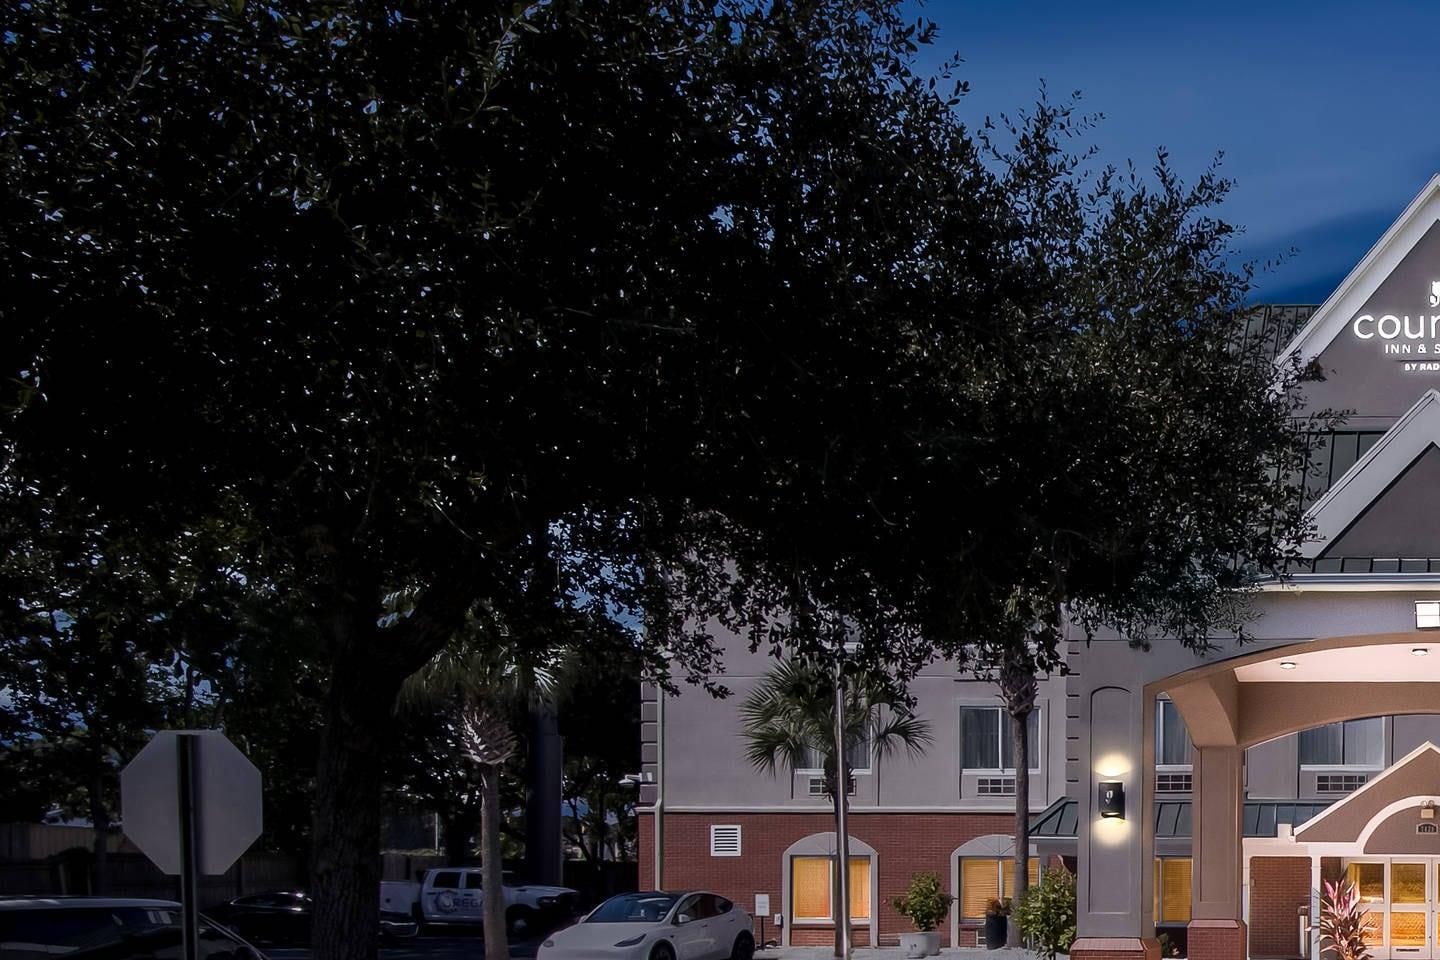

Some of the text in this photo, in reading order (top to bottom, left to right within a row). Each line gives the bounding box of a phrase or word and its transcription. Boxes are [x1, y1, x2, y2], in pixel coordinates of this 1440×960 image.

[1384, 343, 1411, 354] INN
[1417, 343, 1427, 354] &
[1404, 362, 1417, 371] BY
